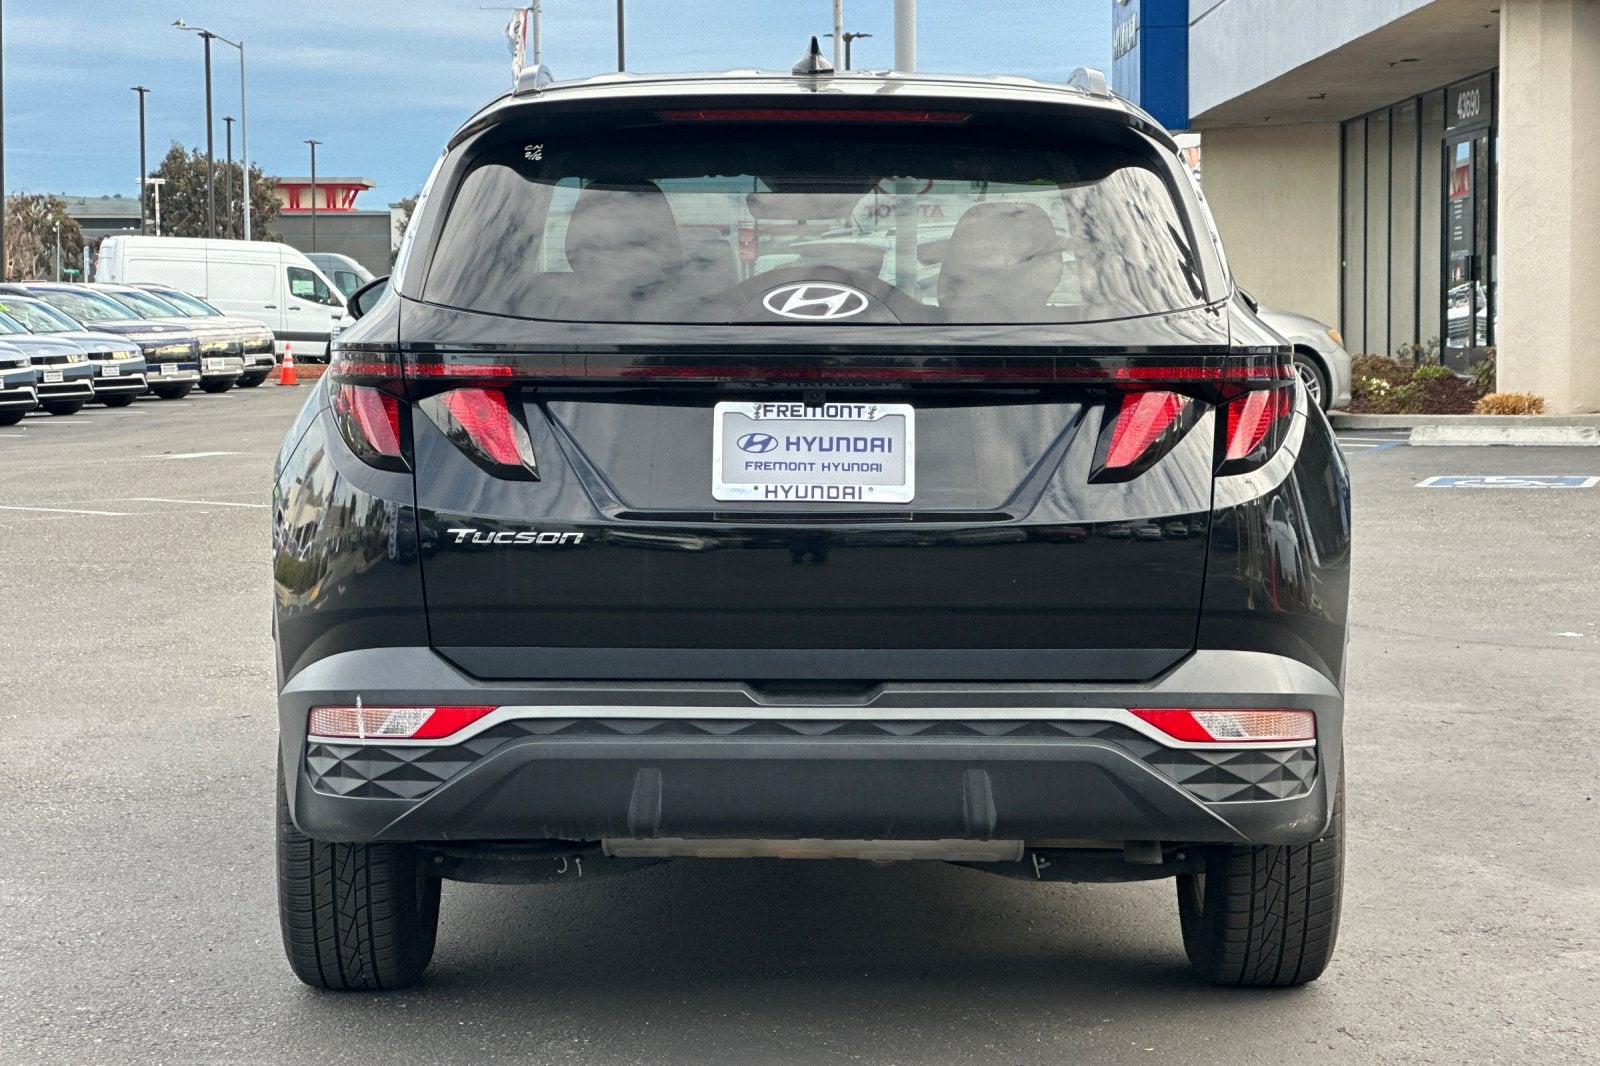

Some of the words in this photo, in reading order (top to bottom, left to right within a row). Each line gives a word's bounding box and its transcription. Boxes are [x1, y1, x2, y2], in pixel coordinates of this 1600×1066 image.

[864, 203, 945, 219] TOTA
[763, 404, 866, 419] FREMONT
[785, 436, 893, 453] HYUNDAI
[744, 461, 816, 472] FREMONT
[821, 462, 883, 473] HYUNDAI
[764, 485, 863, 500] HYUNDAI
